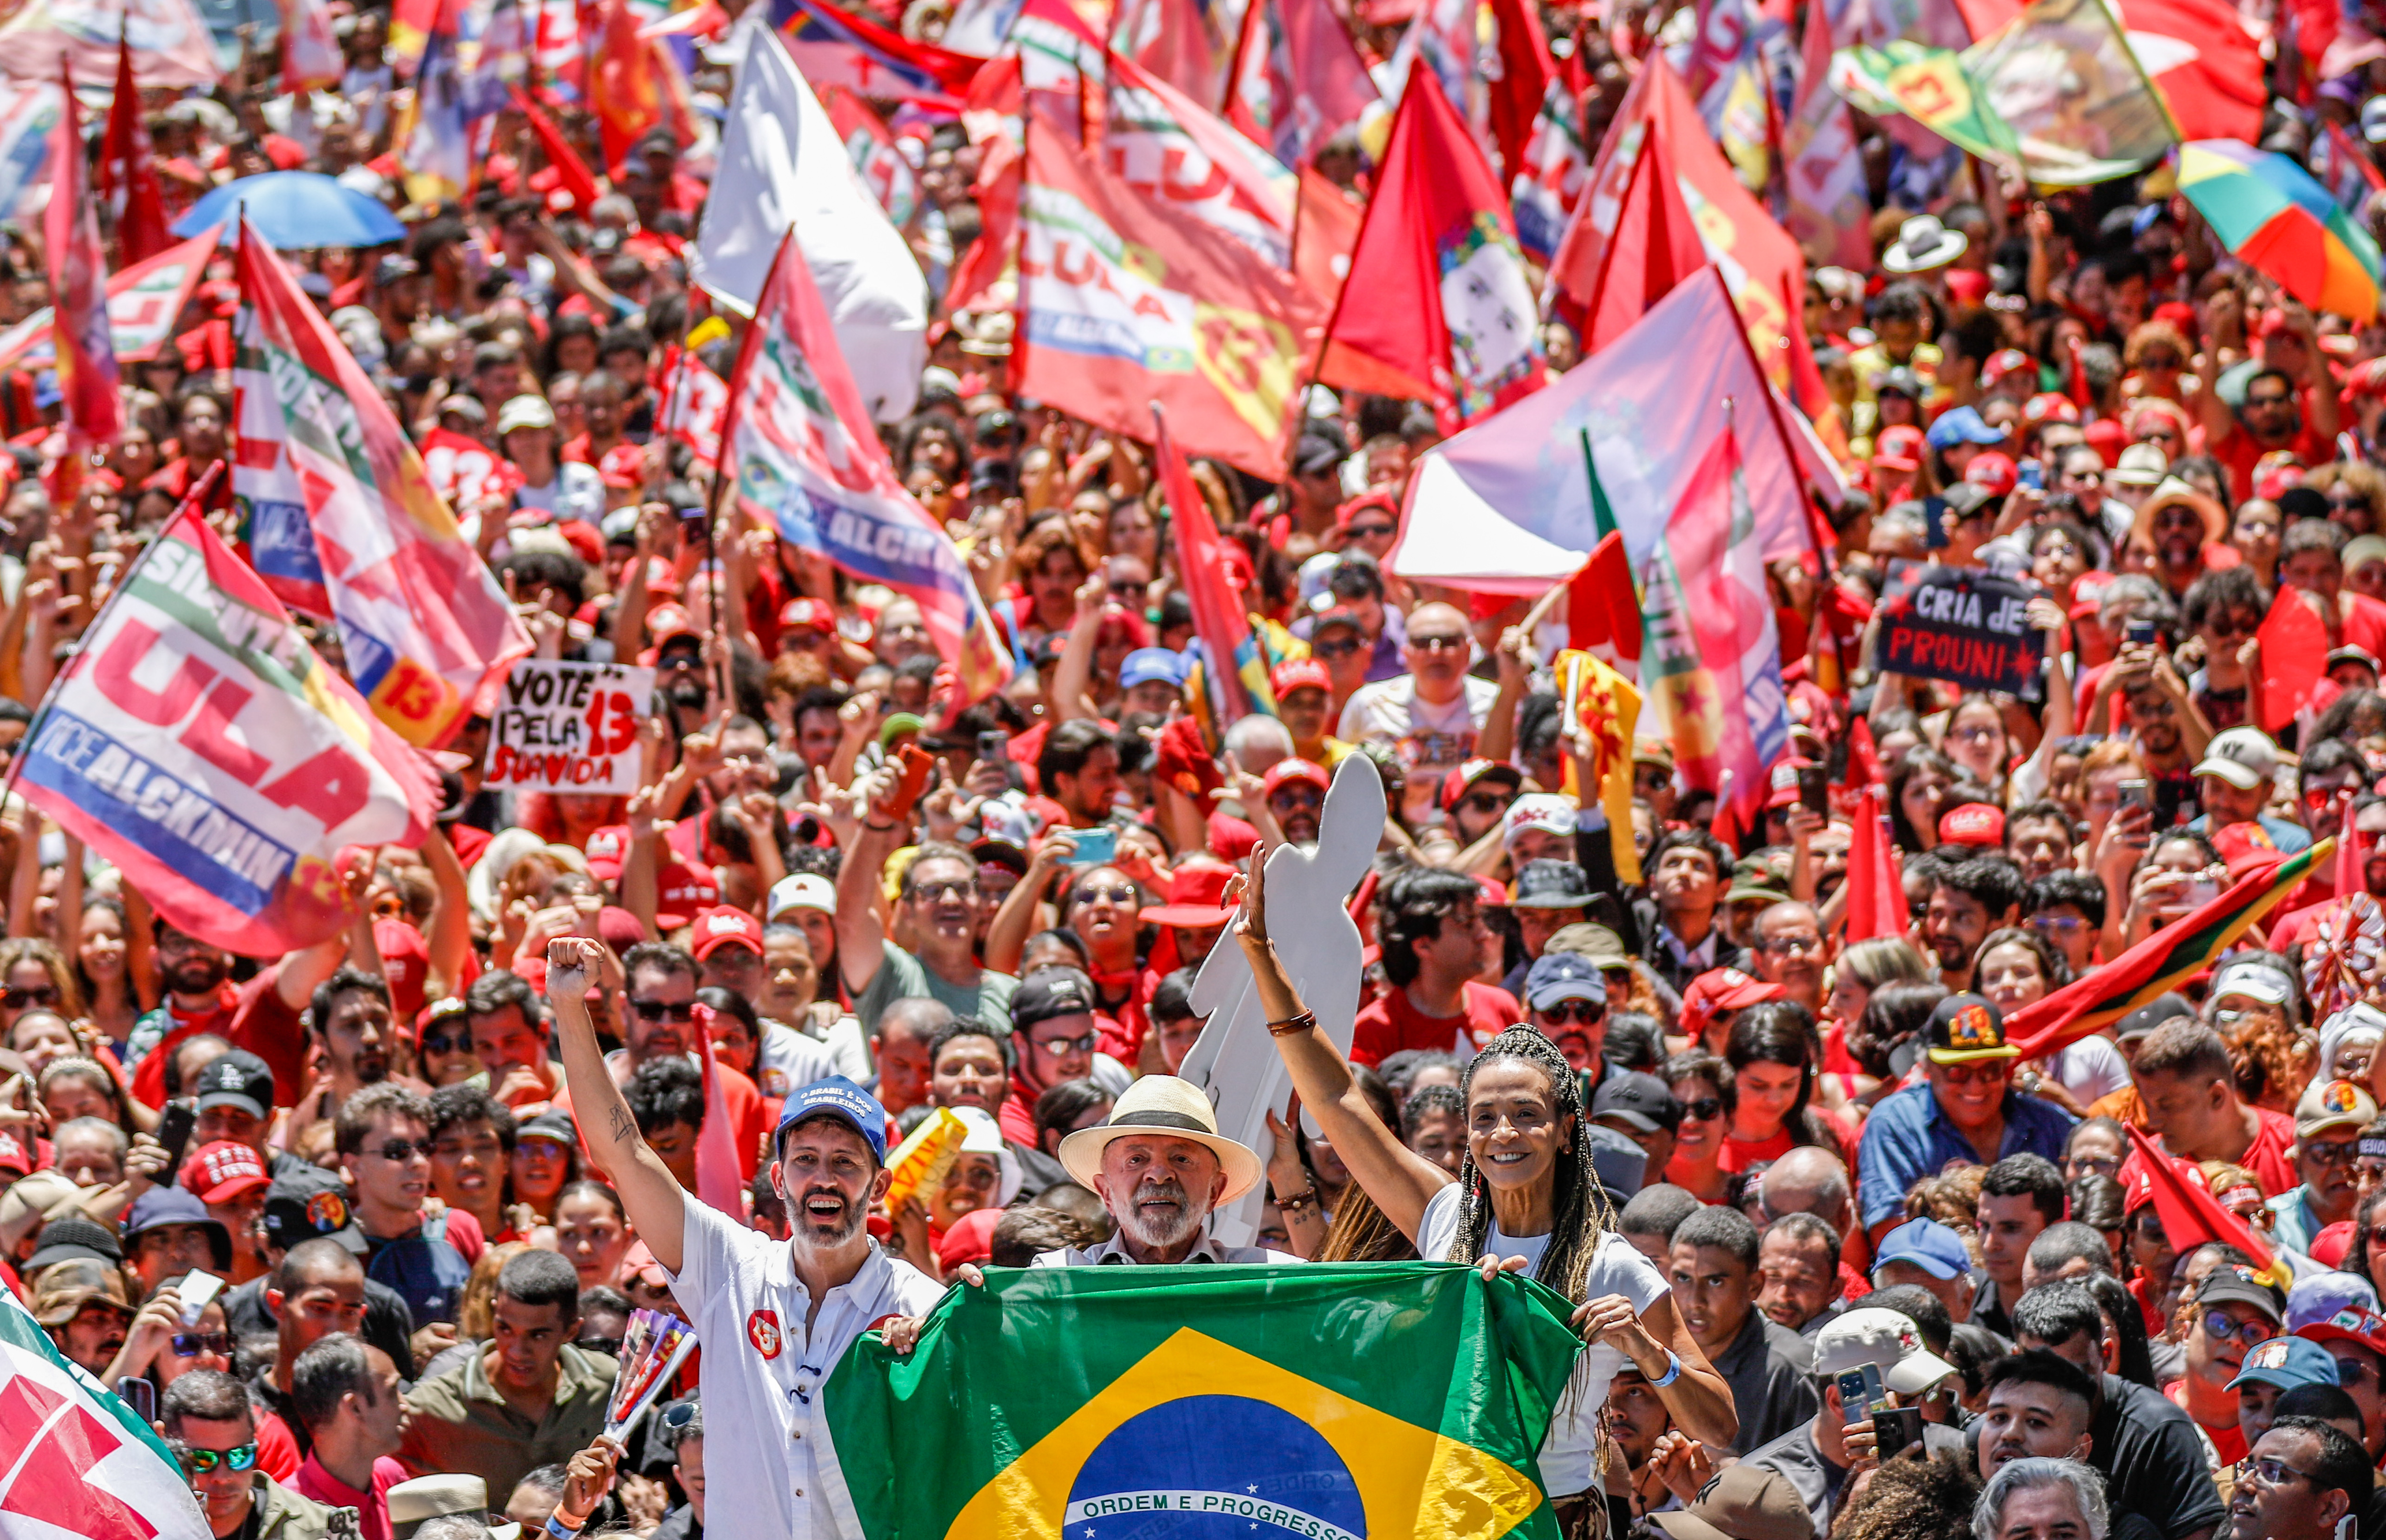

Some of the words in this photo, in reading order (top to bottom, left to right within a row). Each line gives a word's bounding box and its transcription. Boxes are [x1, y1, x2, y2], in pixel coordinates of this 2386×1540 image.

[1888, 626, 2007, 681] PROUNI
[385, 665, 445, 720] 13
[506, 668, 595, 708] VOTE
[498, 708, 580, 746] PELA
[585, 689, 638, 758] 13
[803, 1096, 866, 1119] BRASILEIROS
[809, 1087, 845, 1097] BRASIL
[846, 1090, 855, 1100] É
[855, 1096, 872, 1113] DOS
[1083, 1494, 1168, 1517] ORDEM
[1180, 1496, 1192, 1509] E
